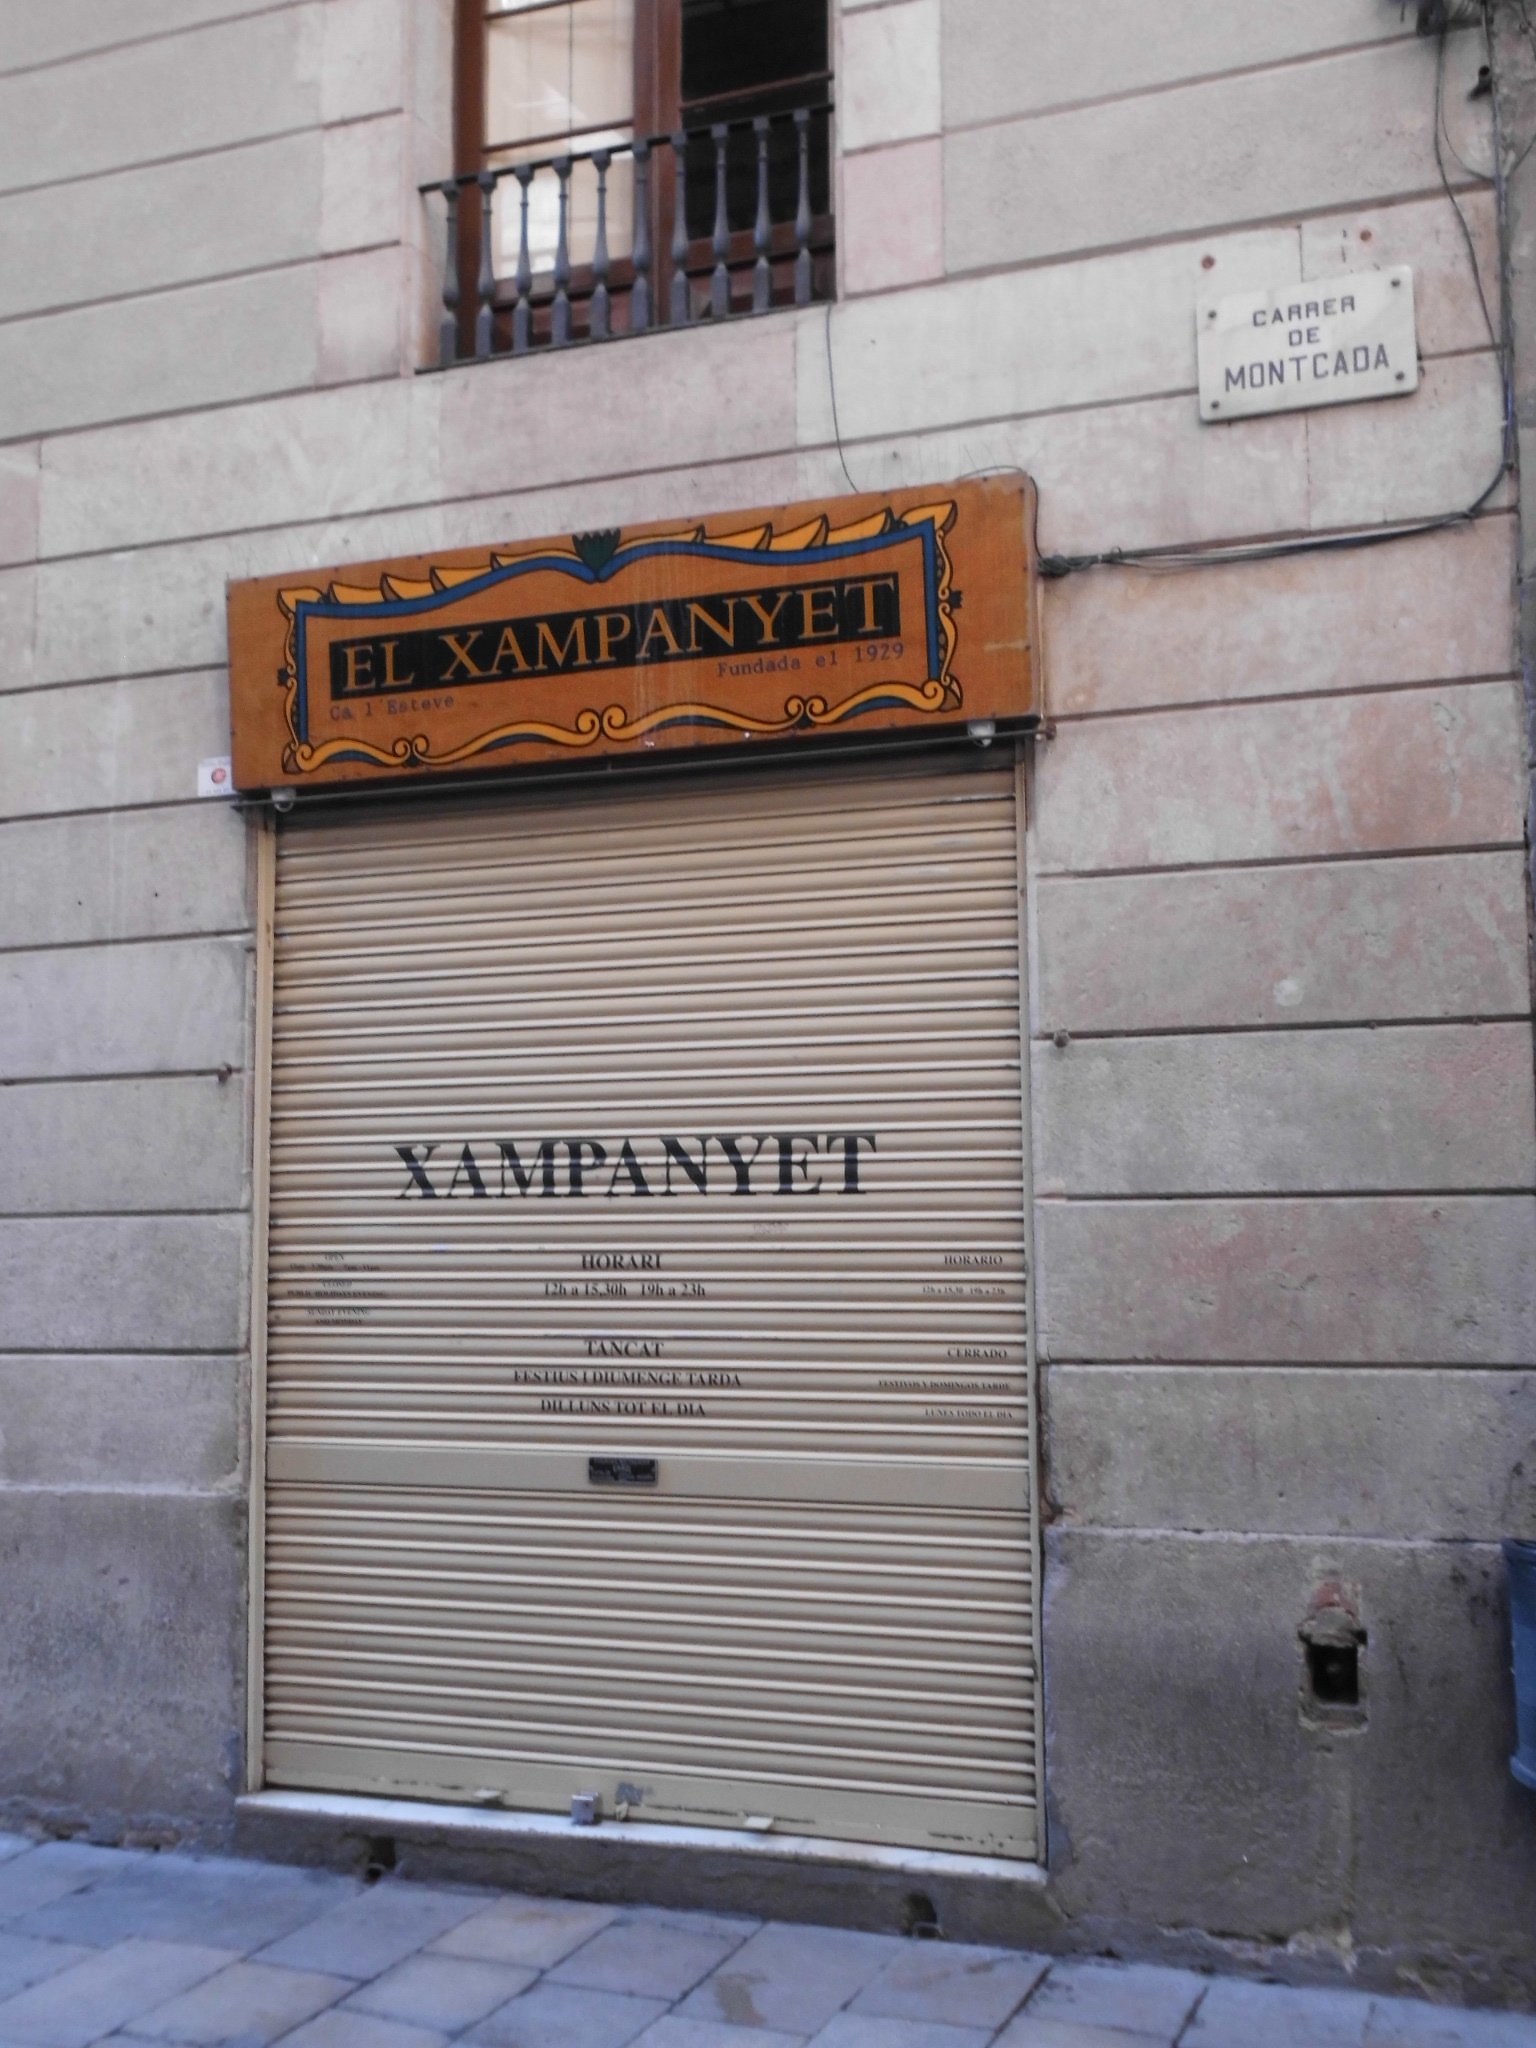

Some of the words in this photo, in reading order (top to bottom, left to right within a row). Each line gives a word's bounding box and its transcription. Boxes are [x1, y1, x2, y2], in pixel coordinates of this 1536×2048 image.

[1253, 295, 1356, 328] CARRER
[1288, 326, 1321, 347] DE
[1224, 343, 1390, 392] MONTCADA
[343, 640, 416, 692] EL
[438, 577, 896, 681] XAMPANYET
[717, 655, 801, 677] Fundada
[855, 642, 905, 663] 1929
[393, 1133, 877, 1200] XAMPANYET
[581, 1253, 662, 1269] HORARI
[943, 1255, 1004, 1265] HORARIO
[544, 1281, 567, 1297] 12h
[571, 1286, 579, 1297] a
[641, 1282, 664, 1297] 19h
[668, 1287, 676, 1297] a
[681, 1282, 706, 1297] 23h
[584, 1340, 665, 1357] TANCAT
[947, 1347, 1008, 1359] CERRADO
[592, 1371, 682, 1385] DIUMENGE
[686, 1373, 742, 1387] TARDA
[541, 1400, 610, 1414] DILLUNS
[615, 1401, 648, 1415] TOT
[651, 1402, 674, 1416] EL
[676, 1402, 707, 1416] DIA
